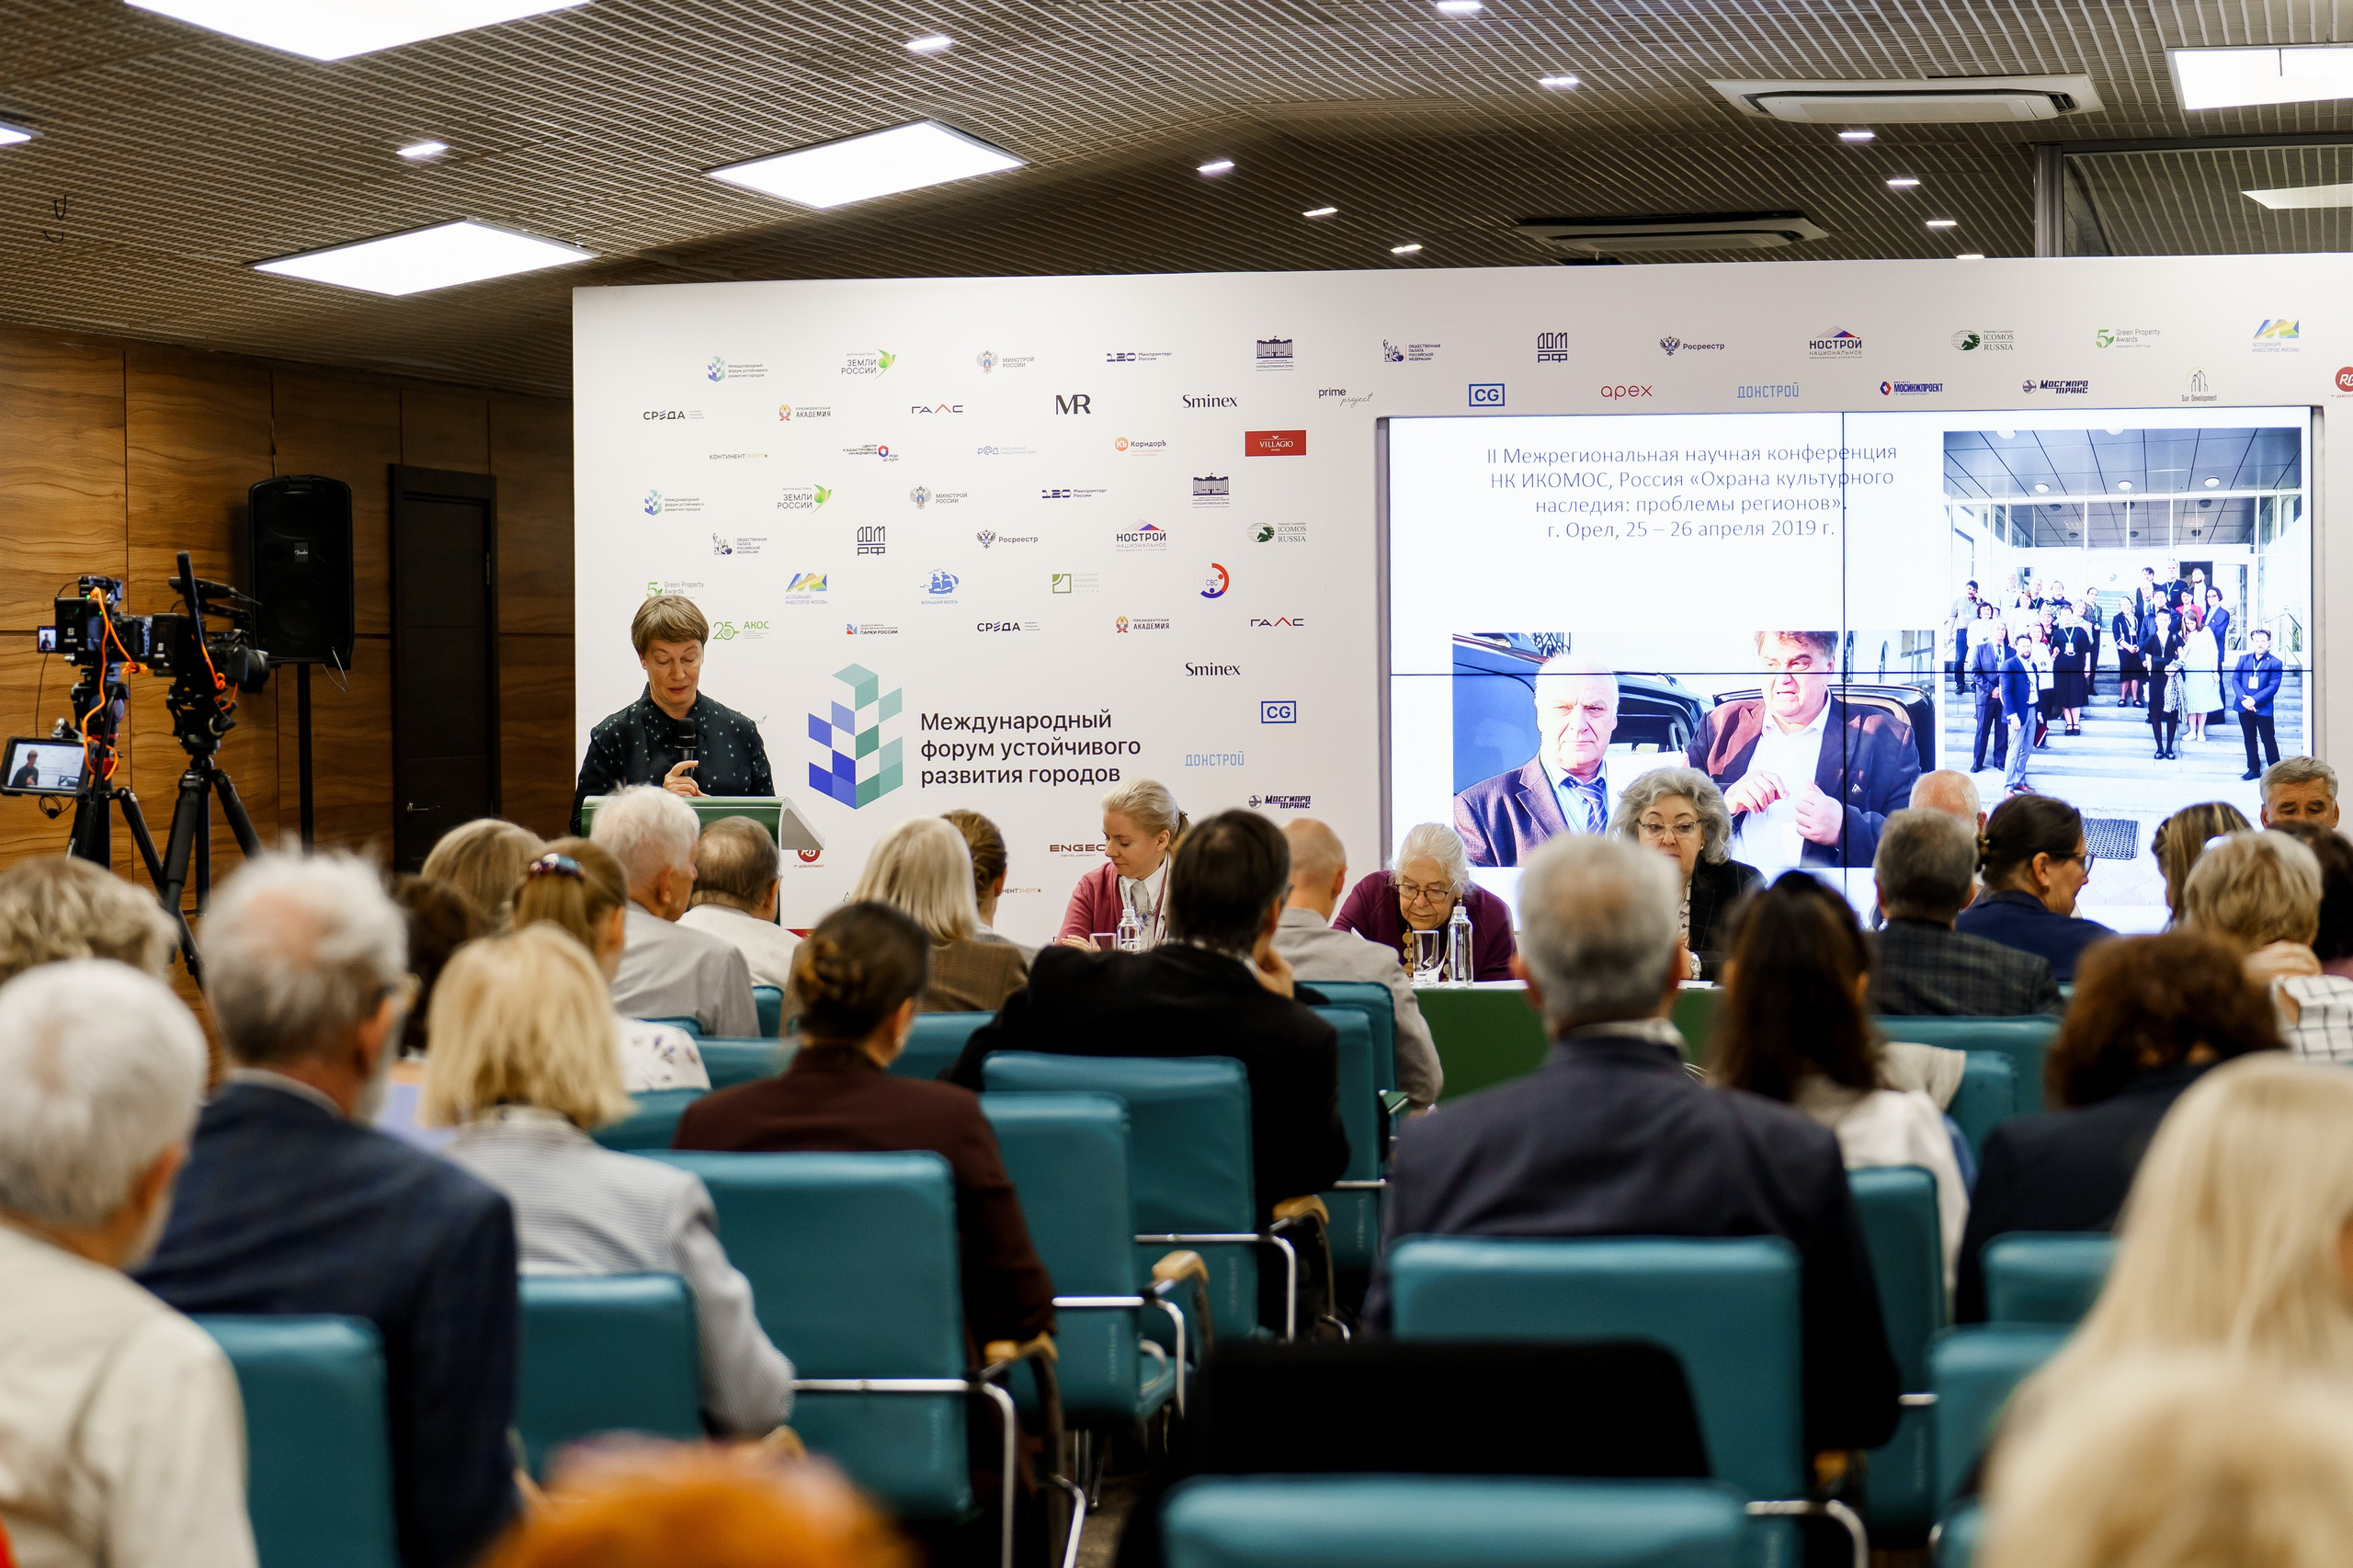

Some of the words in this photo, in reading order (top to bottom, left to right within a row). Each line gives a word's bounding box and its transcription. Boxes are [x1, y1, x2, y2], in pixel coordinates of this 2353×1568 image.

[2135, 328, 2160, 337] Property
[1683, 343, 1725, 351] Росреестр
[847, 358, 877, 367] ЗЕМЛИ
[1107, 352, 1136, 362] 120
[841, 367, 877, 375] РОССИИ
[1318, 387, 1347, 399] prime
[1600, 385, 1653, 401] apex
[1736, 381, 1800, 399] ДОНСТРОЙ
[1893, 383, 1943, 392] МОСИНЖПРОЕКТ
[1182, 394, 1238, 409] Sminex
[1340, 392, 1373, 408] project
[1474, 388, 1499, 402] CG
[2191, 394, 2217, 403] Development
[1055, 394, 1091, 415] MR
[642, 410, 686, 420] СРЕДА
[1486, 449, 1496, 463] II
[1503, 448, 1679, 467] Межрегиональная
[1685, 449, 1761, 466] научная
[1767, 443, 1898, 465] конференция
[1490, 473, 1516, 489] НК
[1521, 472, 1613, 492] ИКОМОС,
[1619, 471, 1684, 488] Россия
[1689, 470, 1771, 491] «Охрана
[1776, 470, 1894, 491] культурного
[1041, 489, 1071, 499] 120
[1535, 497, 1631, 516] наследия:
[1636, 494, 1735, 515] проблемы
[1547, 525, 1560, 539] г.
[1565, 521, 1620, 541] Орел,
[1625, 522, 1648, 538] 25
[1669, 521, 1693, 538] 26
[1698, 524, 1765, 540] апреля
[1770, 520, 1817, 537] 2019
[1822, 523, 1835, 537] г.
[681, 581, 704, 589] Property
[744, 621, 769, 630] АКОС
[977, 621, 1021, 632] СРЕДА
[1185, 662, 1241, 676] Sminex
[1266, 706, 1291, 719] CG
[921, 709, 1111, 734] Международный
[921, 740, 995, 761] форум
[1000, 737, 1142, 760] устойчивого
[1185, 750, 1245, 767] ДОНСТРОЙ
[921, 767, 1023, 788] развития
[1029, 765, 1120, 786] городов
[1265, 795, 1312, 805] МОСГИПРО
